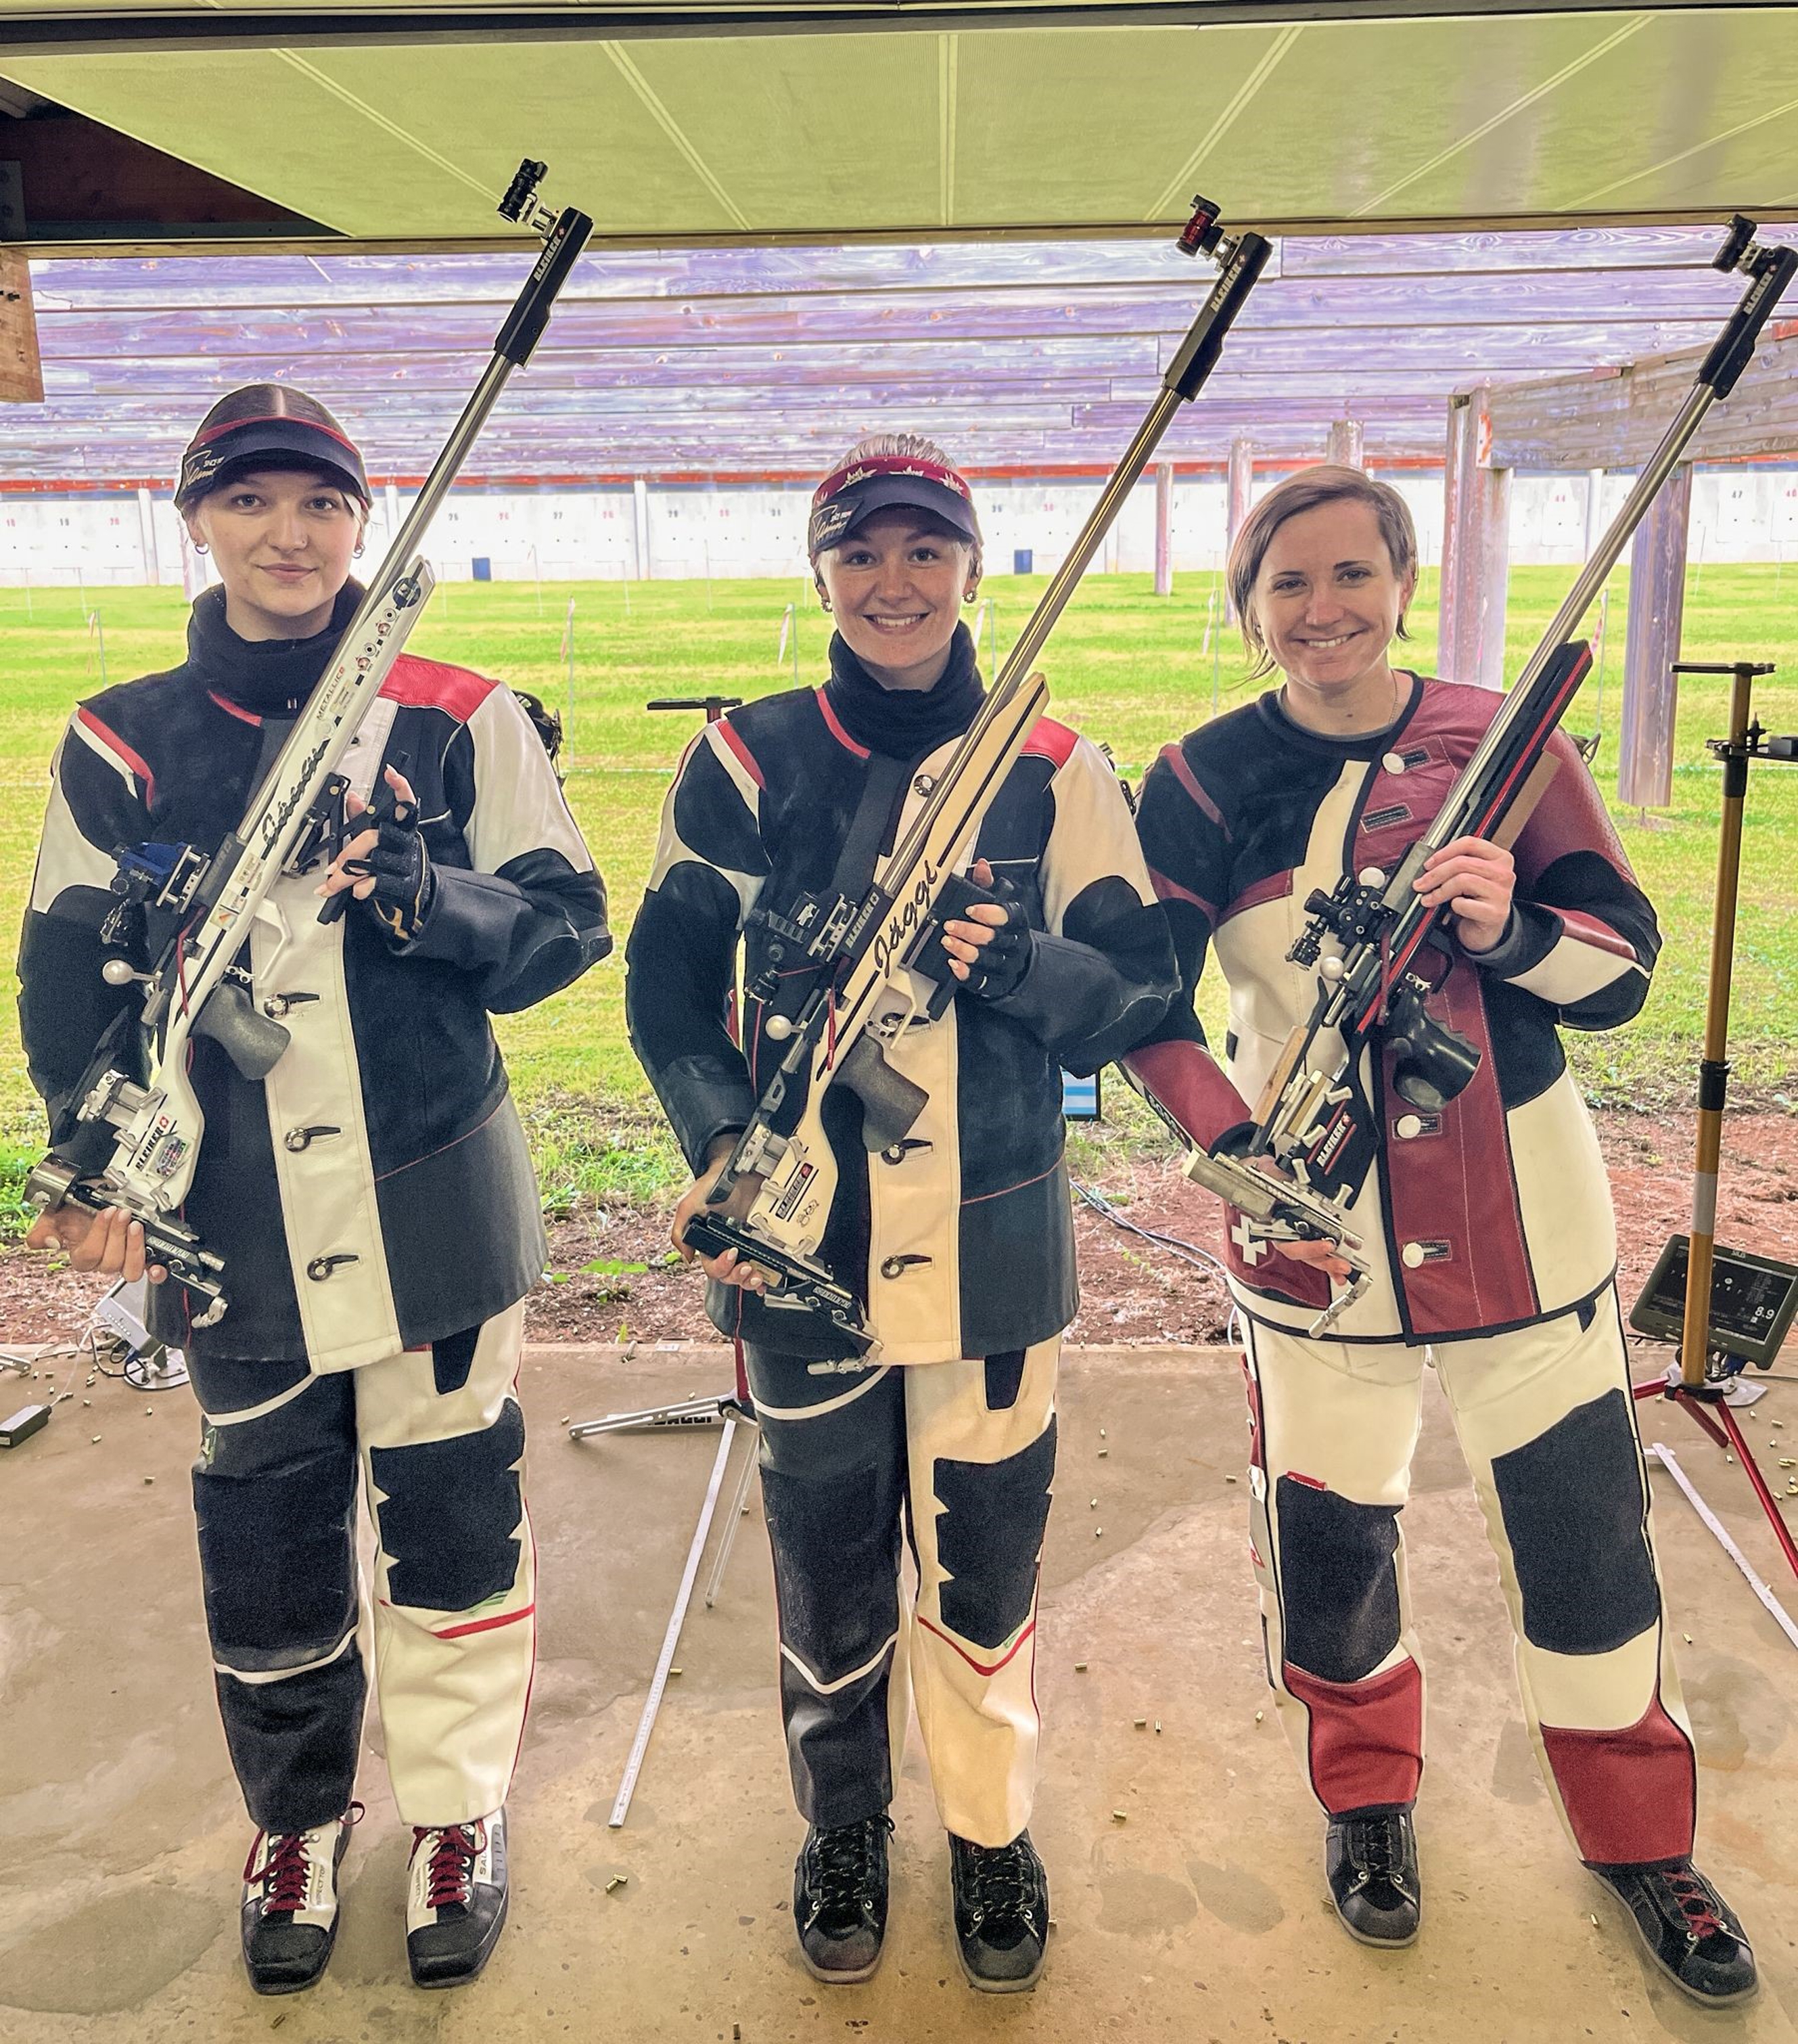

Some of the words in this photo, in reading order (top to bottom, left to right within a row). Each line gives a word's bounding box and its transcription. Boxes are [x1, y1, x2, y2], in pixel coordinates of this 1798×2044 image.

[135, 1126, 164, 1173] BLEIKER
[1316, 1120, 1347, 1168] BLEIKER
[1754, 1306, 1775, 1319] 8.9
